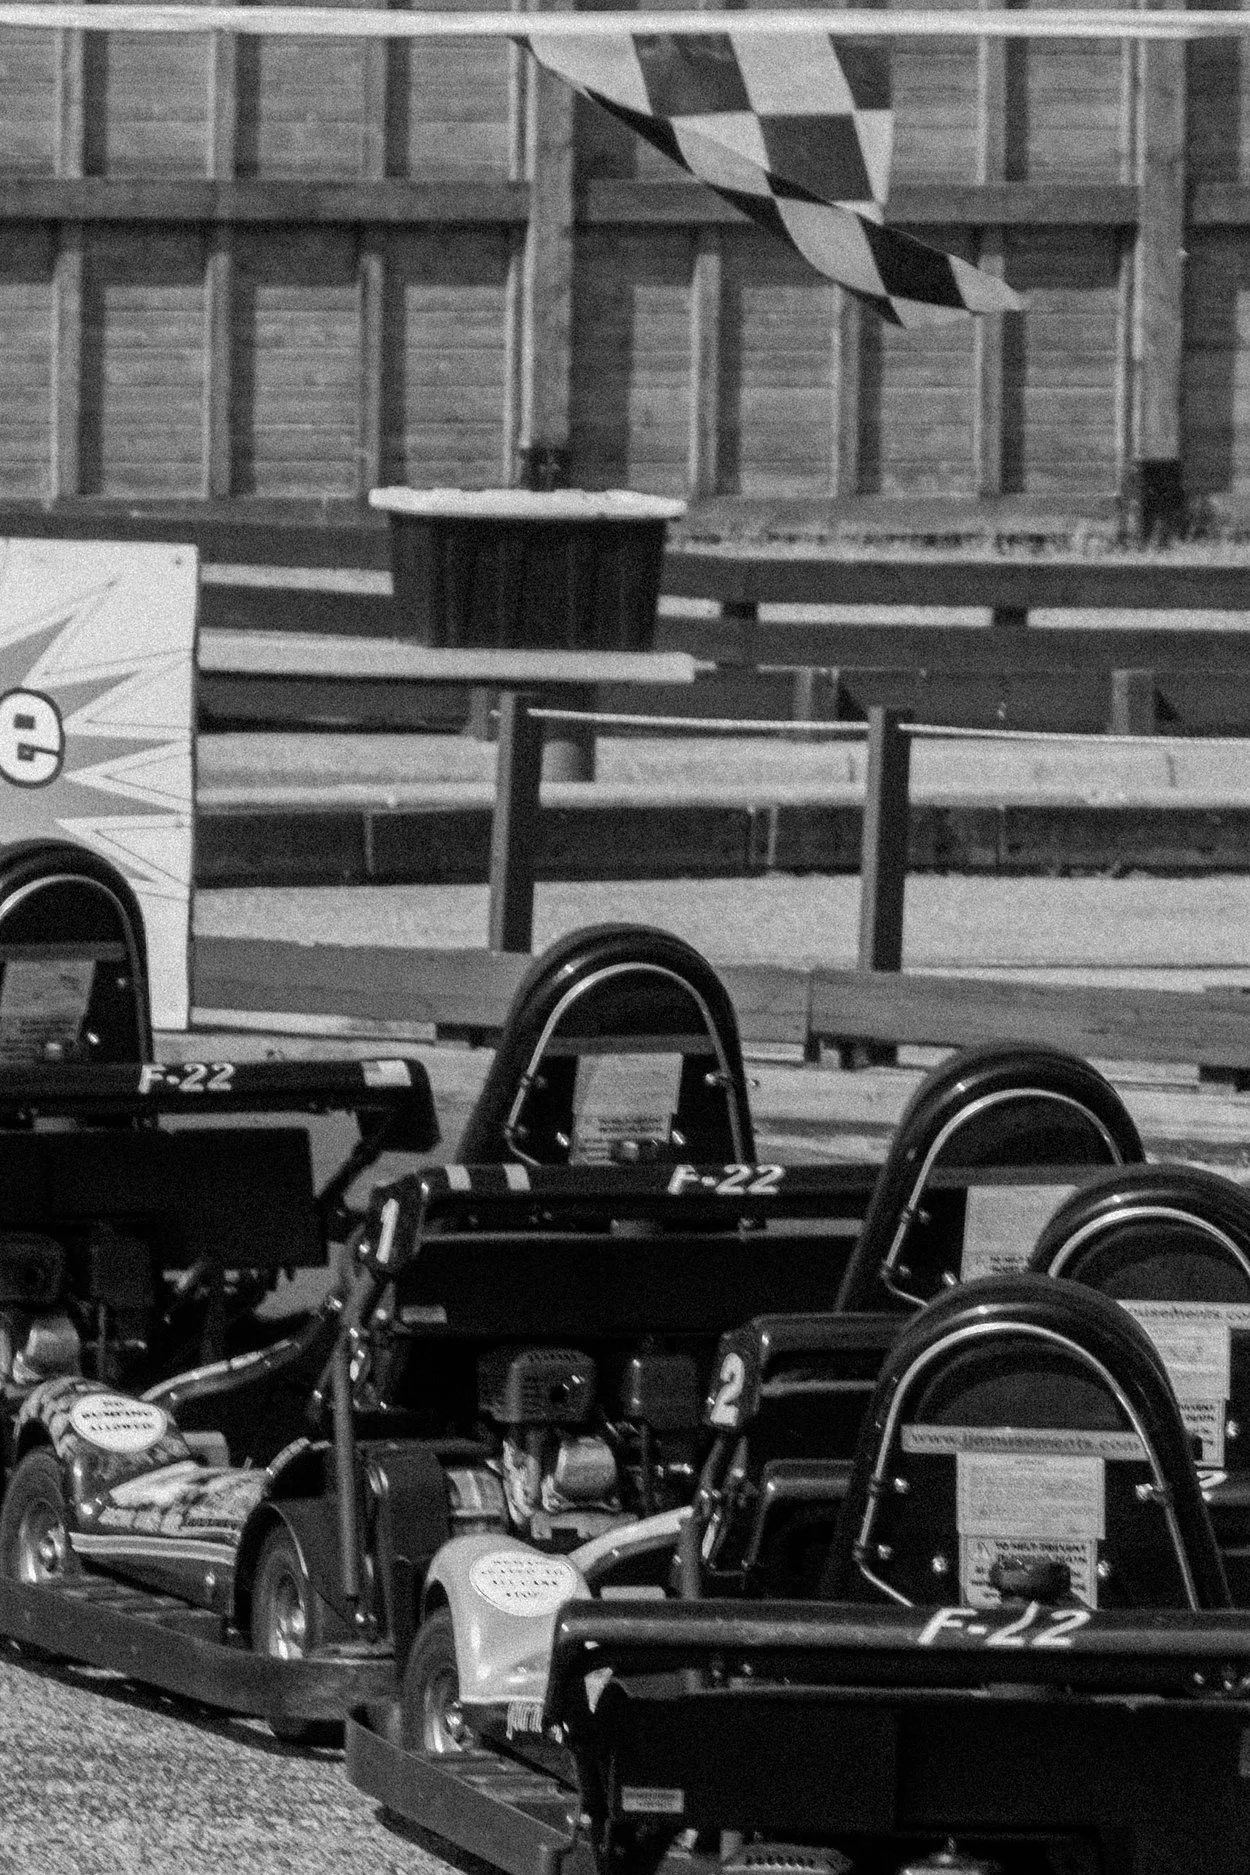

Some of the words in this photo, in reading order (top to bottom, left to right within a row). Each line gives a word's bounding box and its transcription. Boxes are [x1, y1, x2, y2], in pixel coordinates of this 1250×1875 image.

[138, 1063, 235, 1094] F-22
[667, 1164, 785, 1195] F-22
[710, 1352, 744, 1427] 2
[917, 1600, 1091, 1647] F-22
